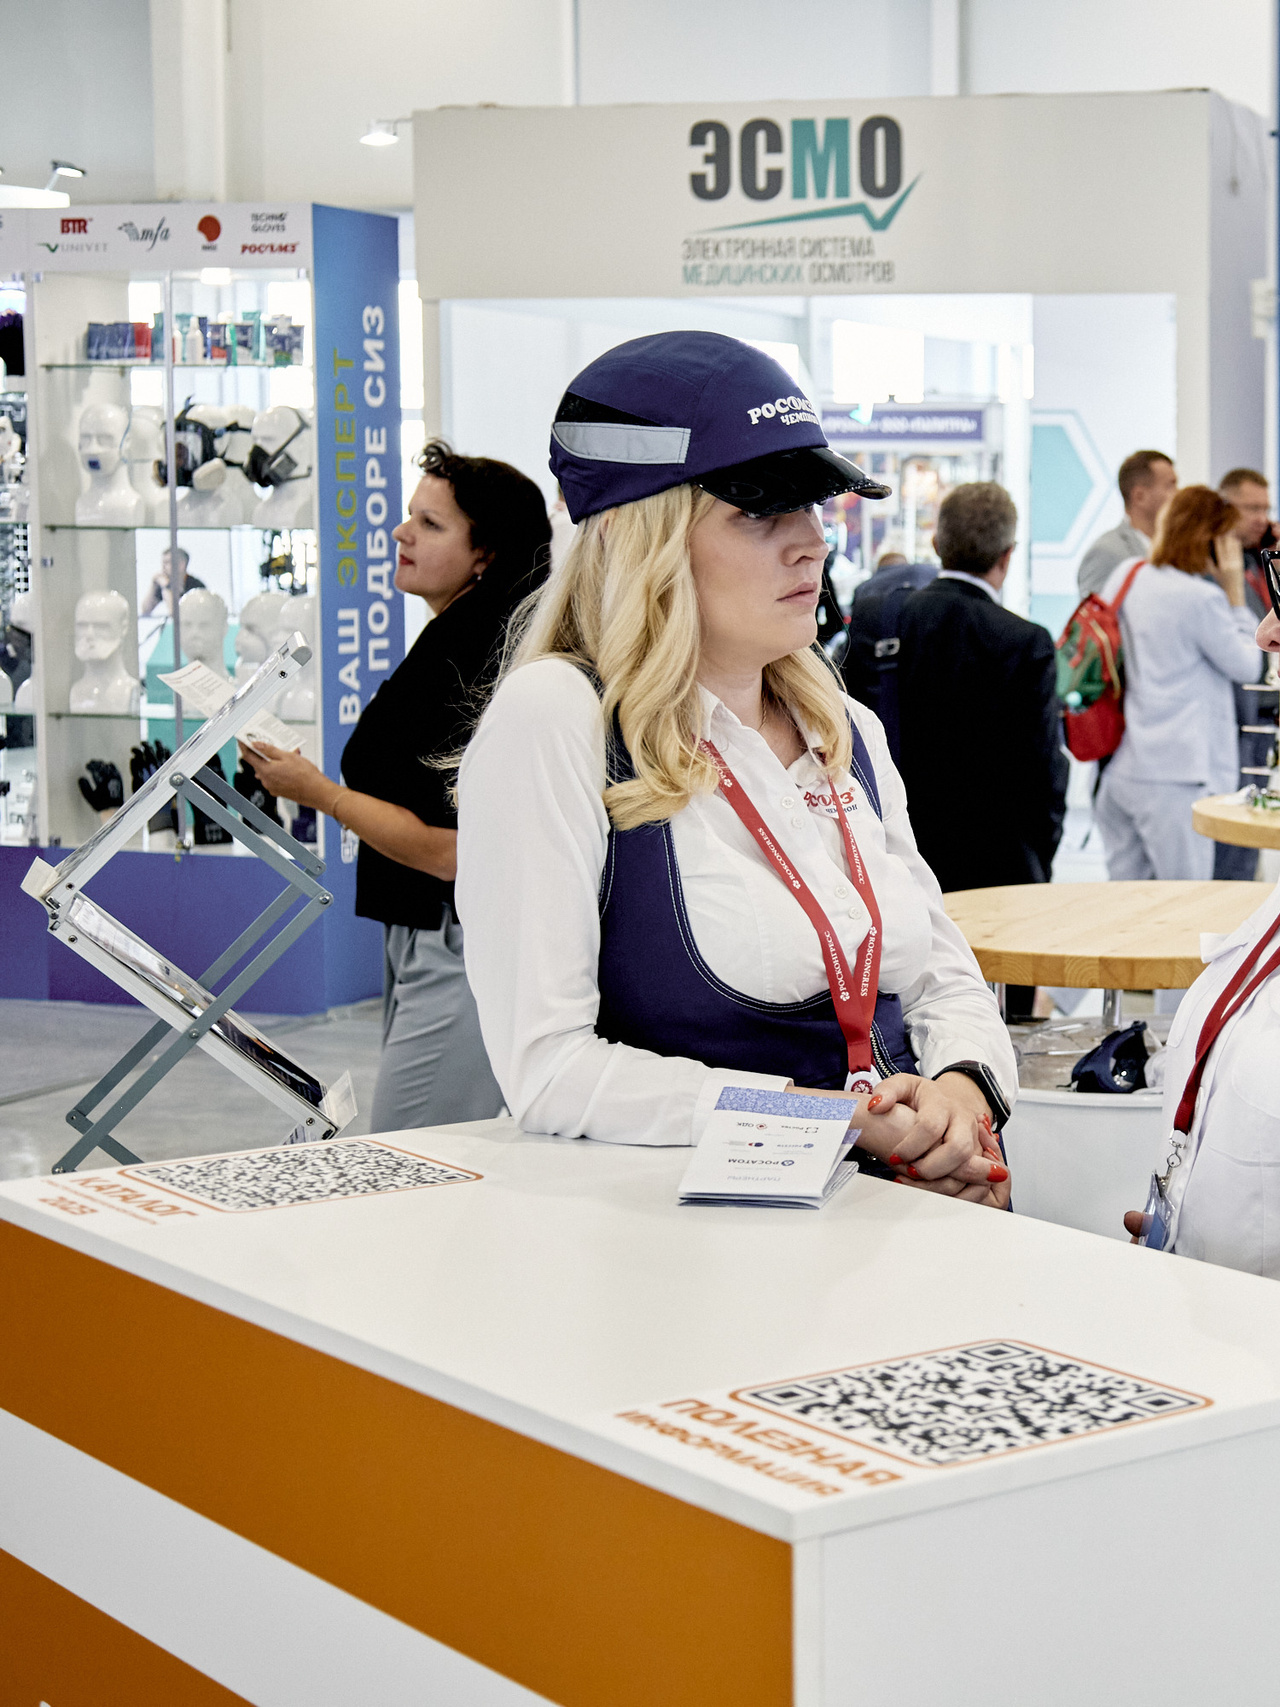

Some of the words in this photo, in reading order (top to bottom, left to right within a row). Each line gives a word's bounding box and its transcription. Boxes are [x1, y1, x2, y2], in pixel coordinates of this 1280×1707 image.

[690, 115, 903, 201] ЭСМО
[60, 217, 88, 234] BTR
[682, 237, 797, 262] ЭЛЕКТРОННАЯ
[800, 236, 875, 260] СИСТЕМА
[682, 262, 803, 286] МЕДИЦИНСКИХ
[809, 261, 895, 284] ОСМОТРОВ
[362, 304, 386, 408] СИЗ
[333, 347, 358, 586] ЭКСПЕРТ
[365, 426, 392, 671] ПОДБОРЕ
[337, 608, 361, 725] ВАШ
[758, 827, 796, 881] ROSCONGRESS
[824, 930, 847, 992] РОСКОНГРЕСС
[860, 936, 876, 997] ROSCONGRESS
[70, 1177, 199, 1216] КАТАЛОГ
[613, 1409, 845, 1498] ИНФОРМАЦИЯ
[660, 1399, 905, 1487] ПОЛЕЗНАЯ
